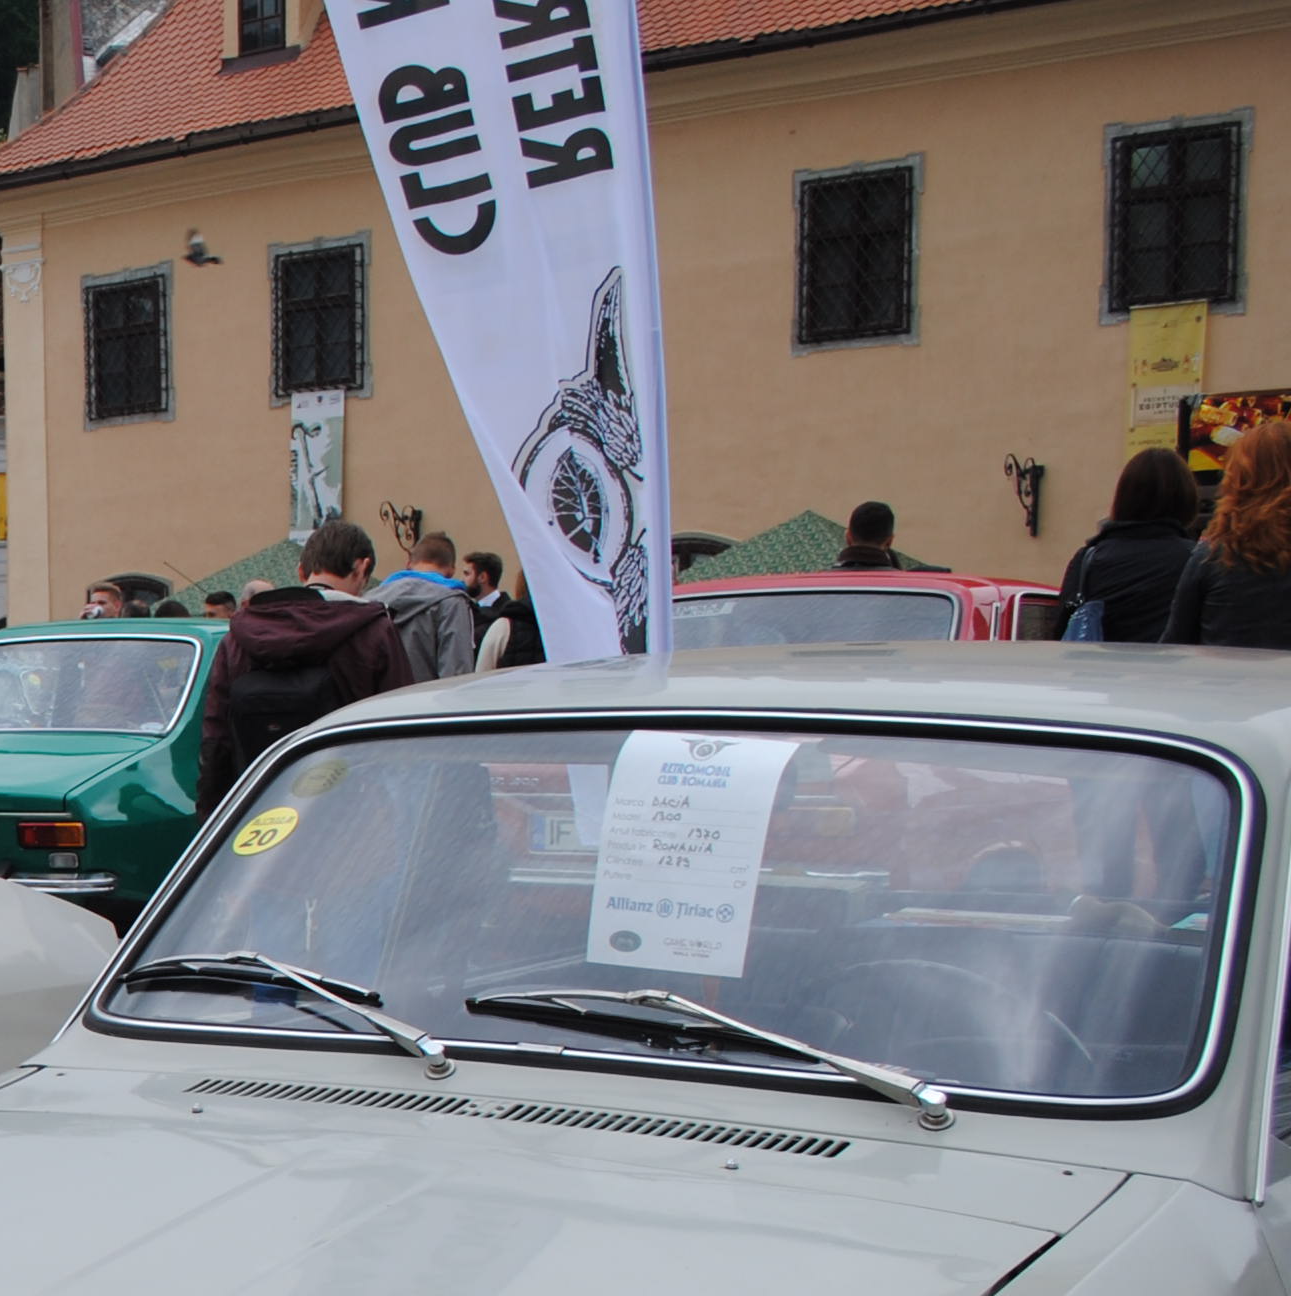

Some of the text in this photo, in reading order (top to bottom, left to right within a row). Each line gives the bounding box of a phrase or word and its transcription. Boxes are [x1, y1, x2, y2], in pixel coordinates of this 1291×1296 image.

[660, 762, 731, 777] RETROMOBIL
[657, 775, 678, 785] CLUB
[239, 828, 278, 848] 20
[687, 828, 721, 841] 1970
[606, 896, 654, 913] Allianz
